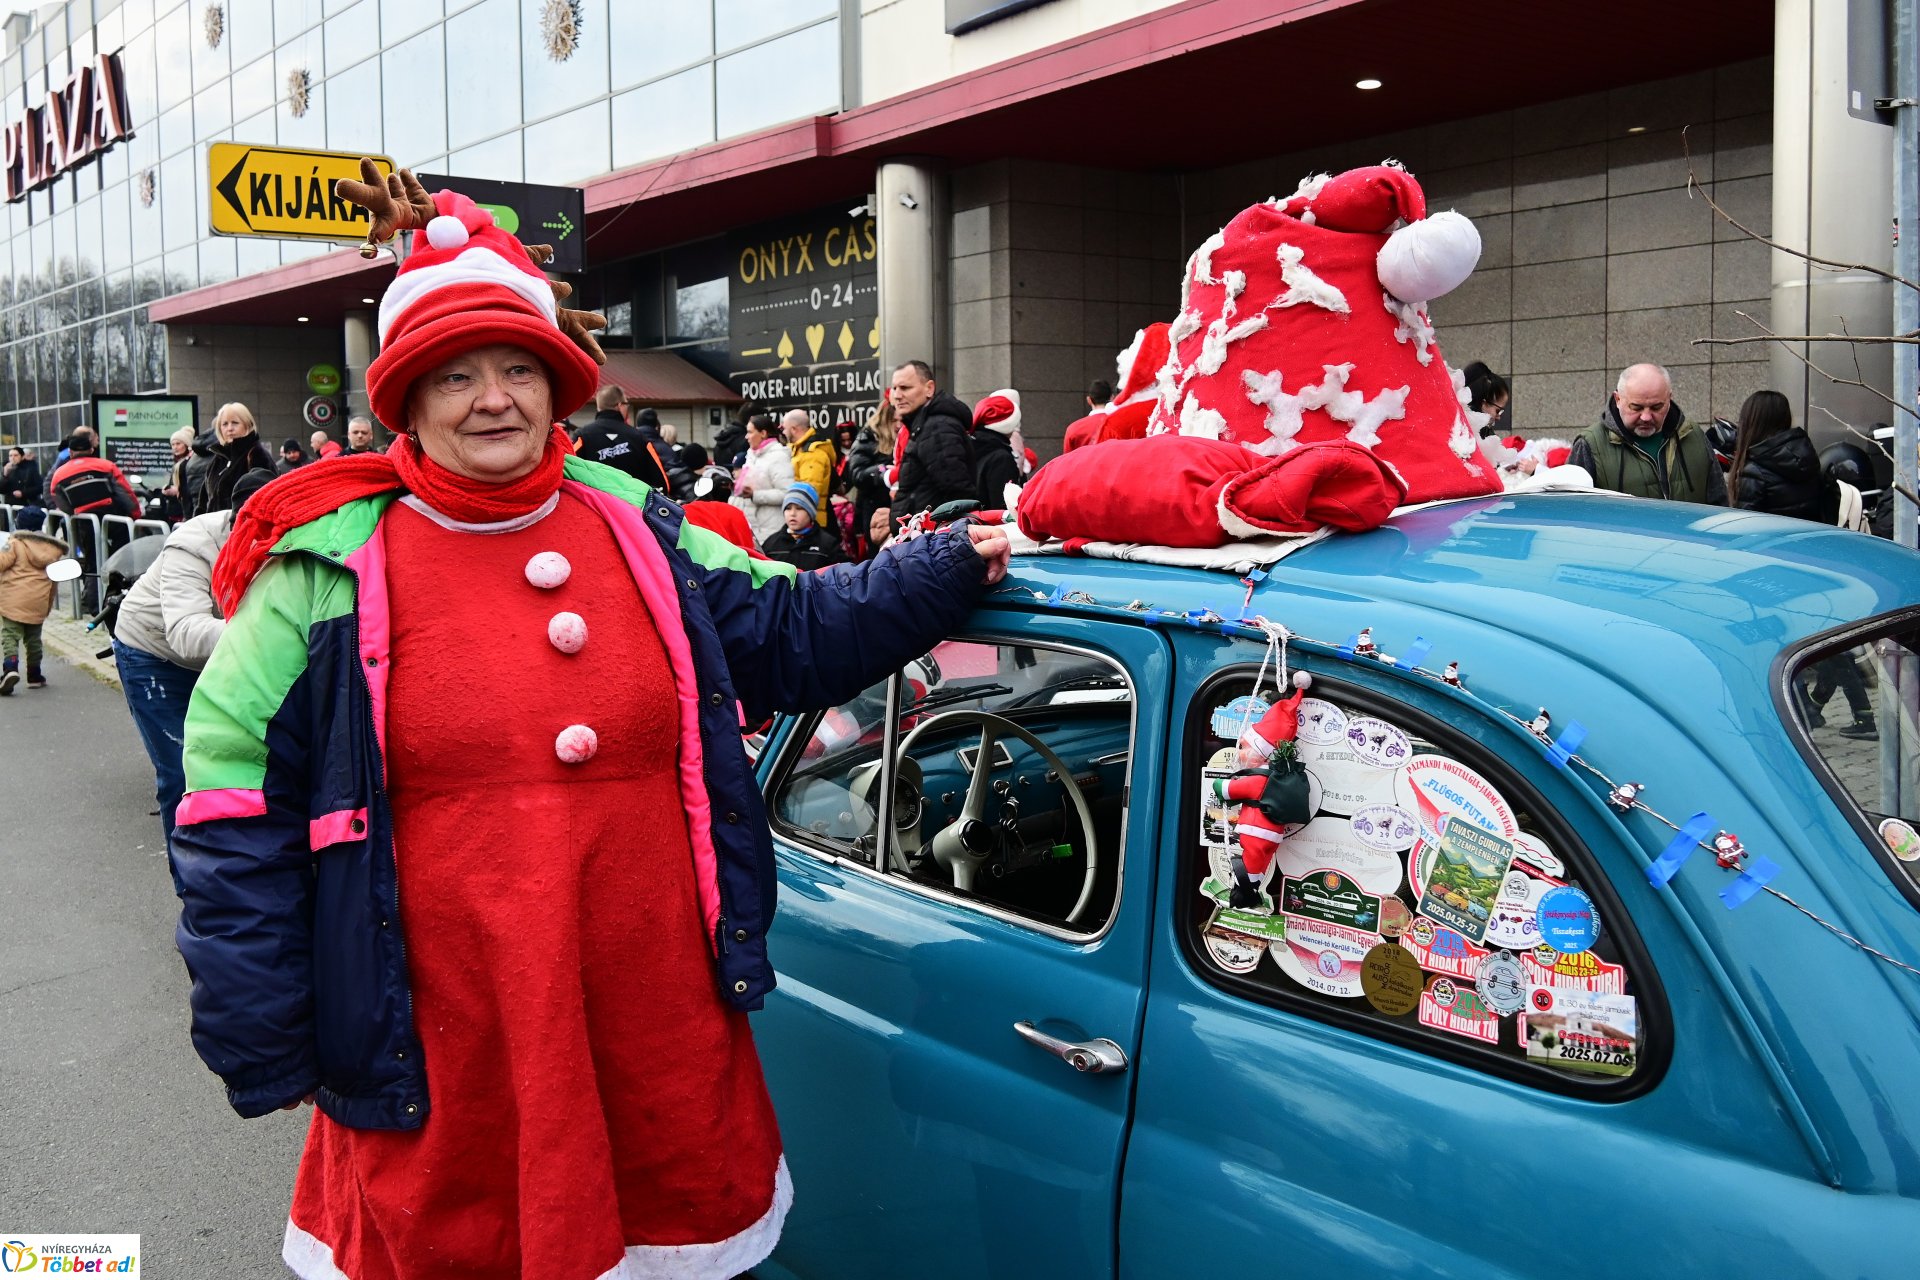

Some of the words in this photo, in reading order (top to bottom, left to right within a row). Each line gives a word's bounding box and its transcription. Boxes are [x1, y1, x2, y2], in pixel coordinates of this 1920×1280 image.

[4, 53, 134, 200] PLAZA
[249, 166, 370, 223] KIJÁRA
[740, 233, 815, 284] ONYX
[824, 219, 877, 267] CAS
[810, 281, 853, 310] 0-24
[741, 369, 880, 400] POKER-RULETT-BLAC
[128, 410, 179, 419] PANNÓNIA
[836, 406, 877, 427] AUTO
[1406, 759, 1441, 775] PÁZMÁNDI
[1443, 763, 1501, 807] NOSZTALGIA-JÁRMŰ
[1496, 805, 1515, 838] EGYESÜL
[1450, 821, 1477, 842] TAVASZI
[1478, 835, 1512, 858] GURULÁS
[1457, 839, 1500, 865] ZEMPLÉNBEN
[1426, 901, 1478, 936] 2025.04.25-27.
[1428, 950, 1460, 973] HIDAK
[1554, 972, 1589, 992] HIDAK
[1590, 968, 1620, 995] TÚRA
[1422, 995, 1449, 1027] IPOLY
[1449, 1013, 1480, 1035] HIDAK
[1481, 1016, 1499, 1040] TÚ
[1494, 1000, 1527, 1015] HUNGAR
